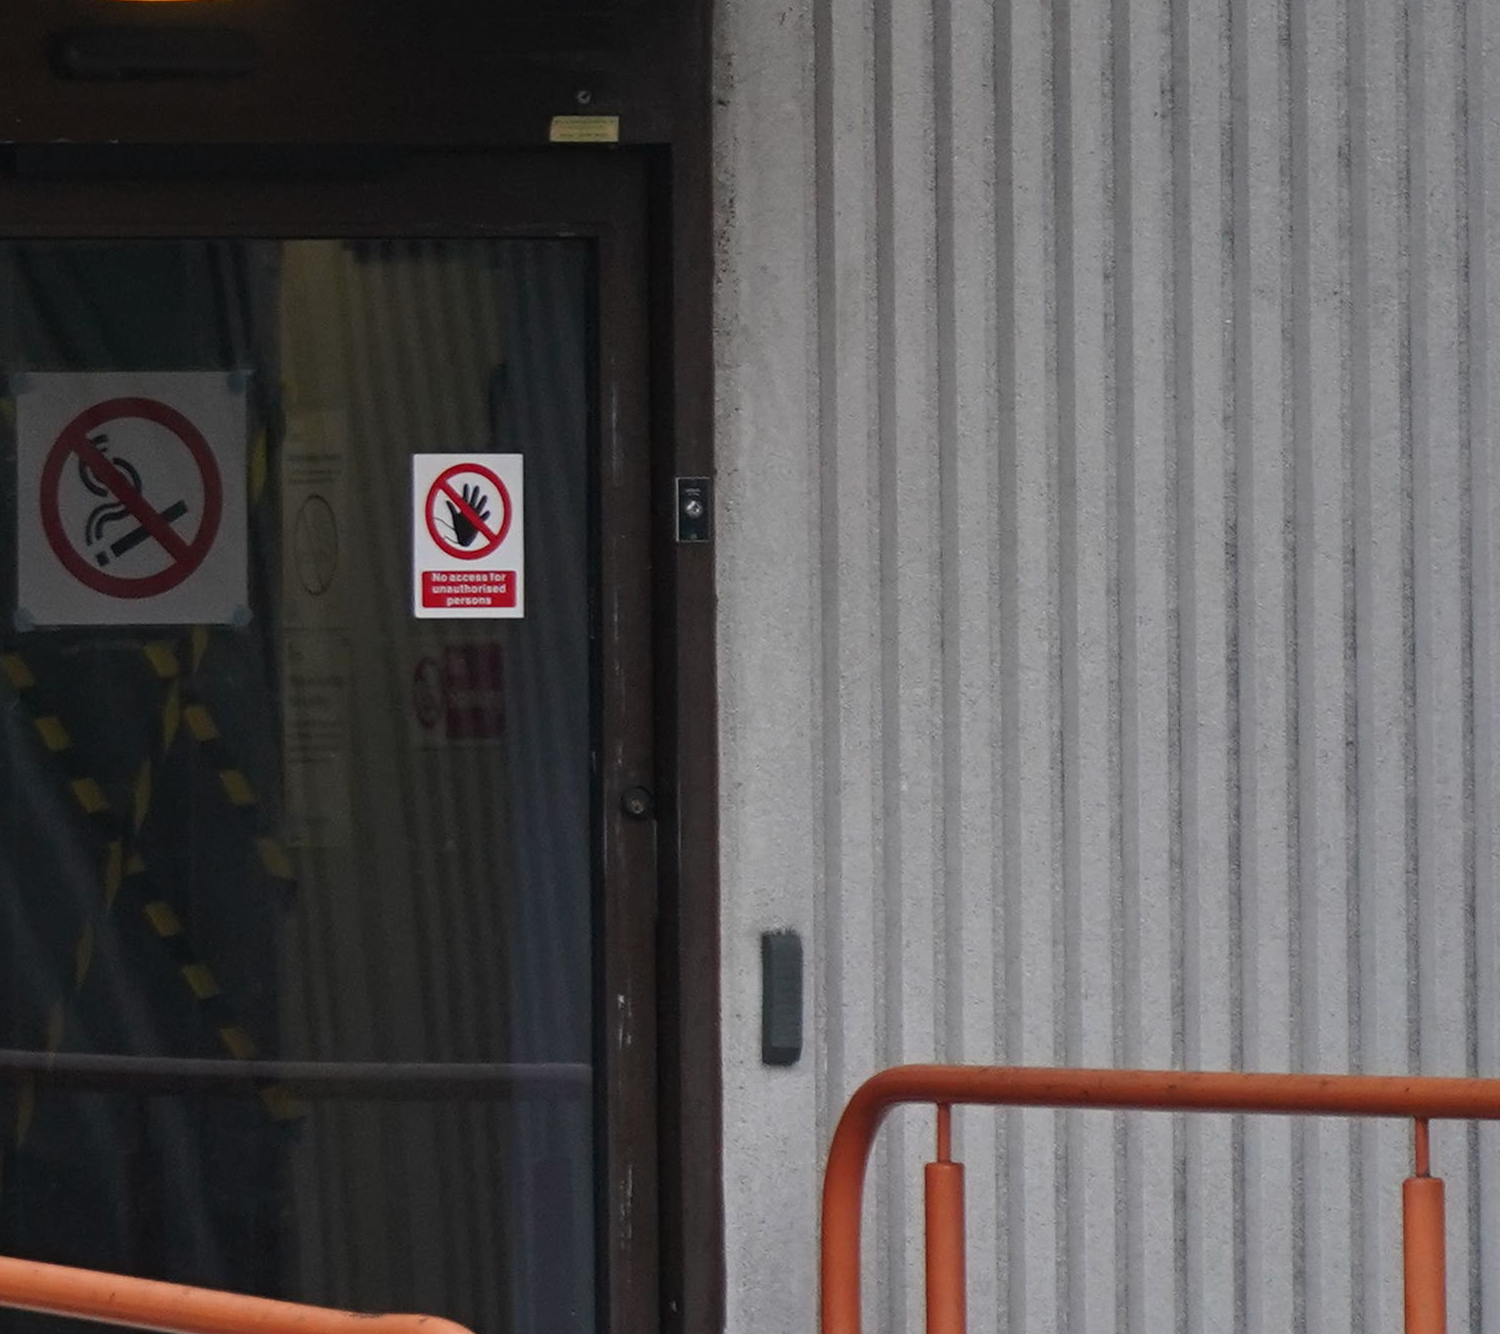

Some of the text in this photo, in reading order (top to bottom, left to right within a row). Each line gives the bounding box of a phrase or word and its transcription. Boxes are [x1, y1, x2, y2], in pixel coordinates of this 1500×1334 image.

[431, 572, 507, 582] No access for
[431, 583, 507, 594] unauthorised
[446, 596, 492, 607] persons
